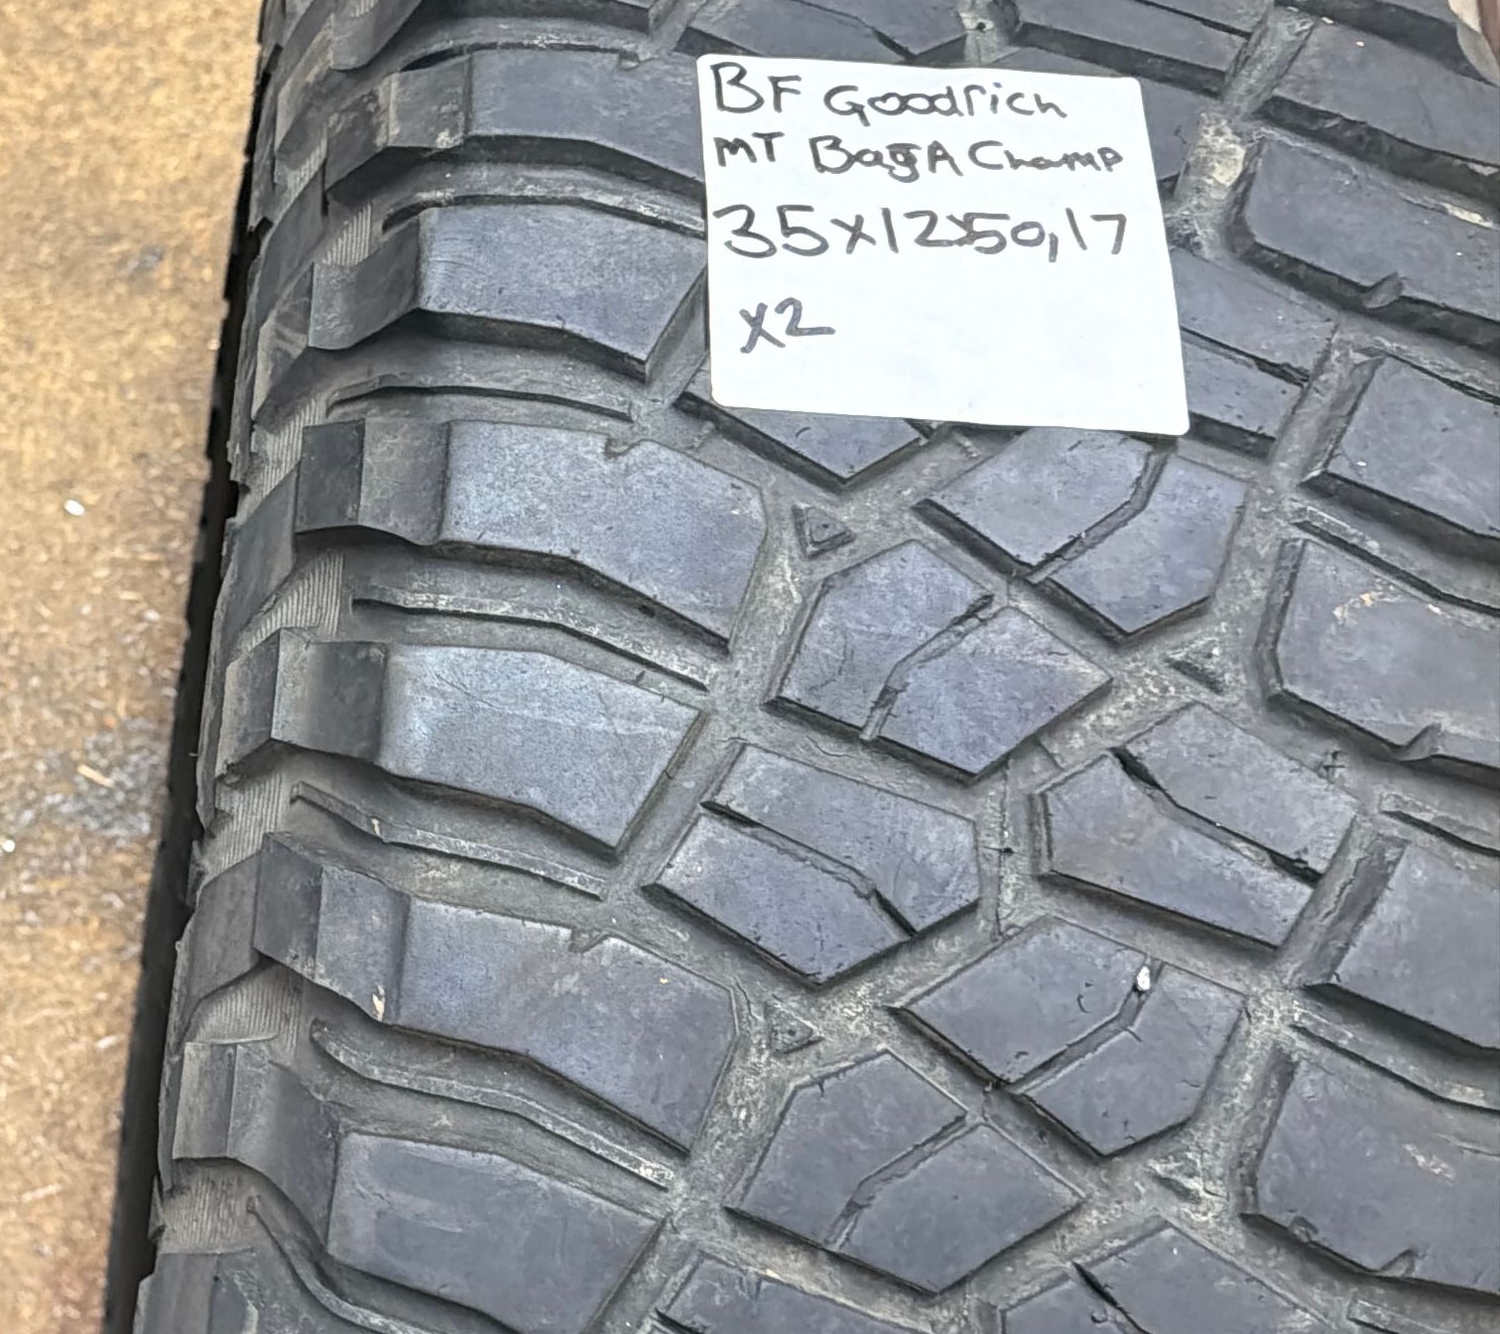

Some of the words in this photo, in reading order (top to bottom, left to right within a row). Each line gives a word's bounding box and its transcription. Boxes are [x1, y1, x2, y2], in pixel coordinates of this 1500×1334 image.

[710, 61, 802, 114] BF
[823, 81, 1067, 127] Goodrich
[713, 131, 785, 168] MT
